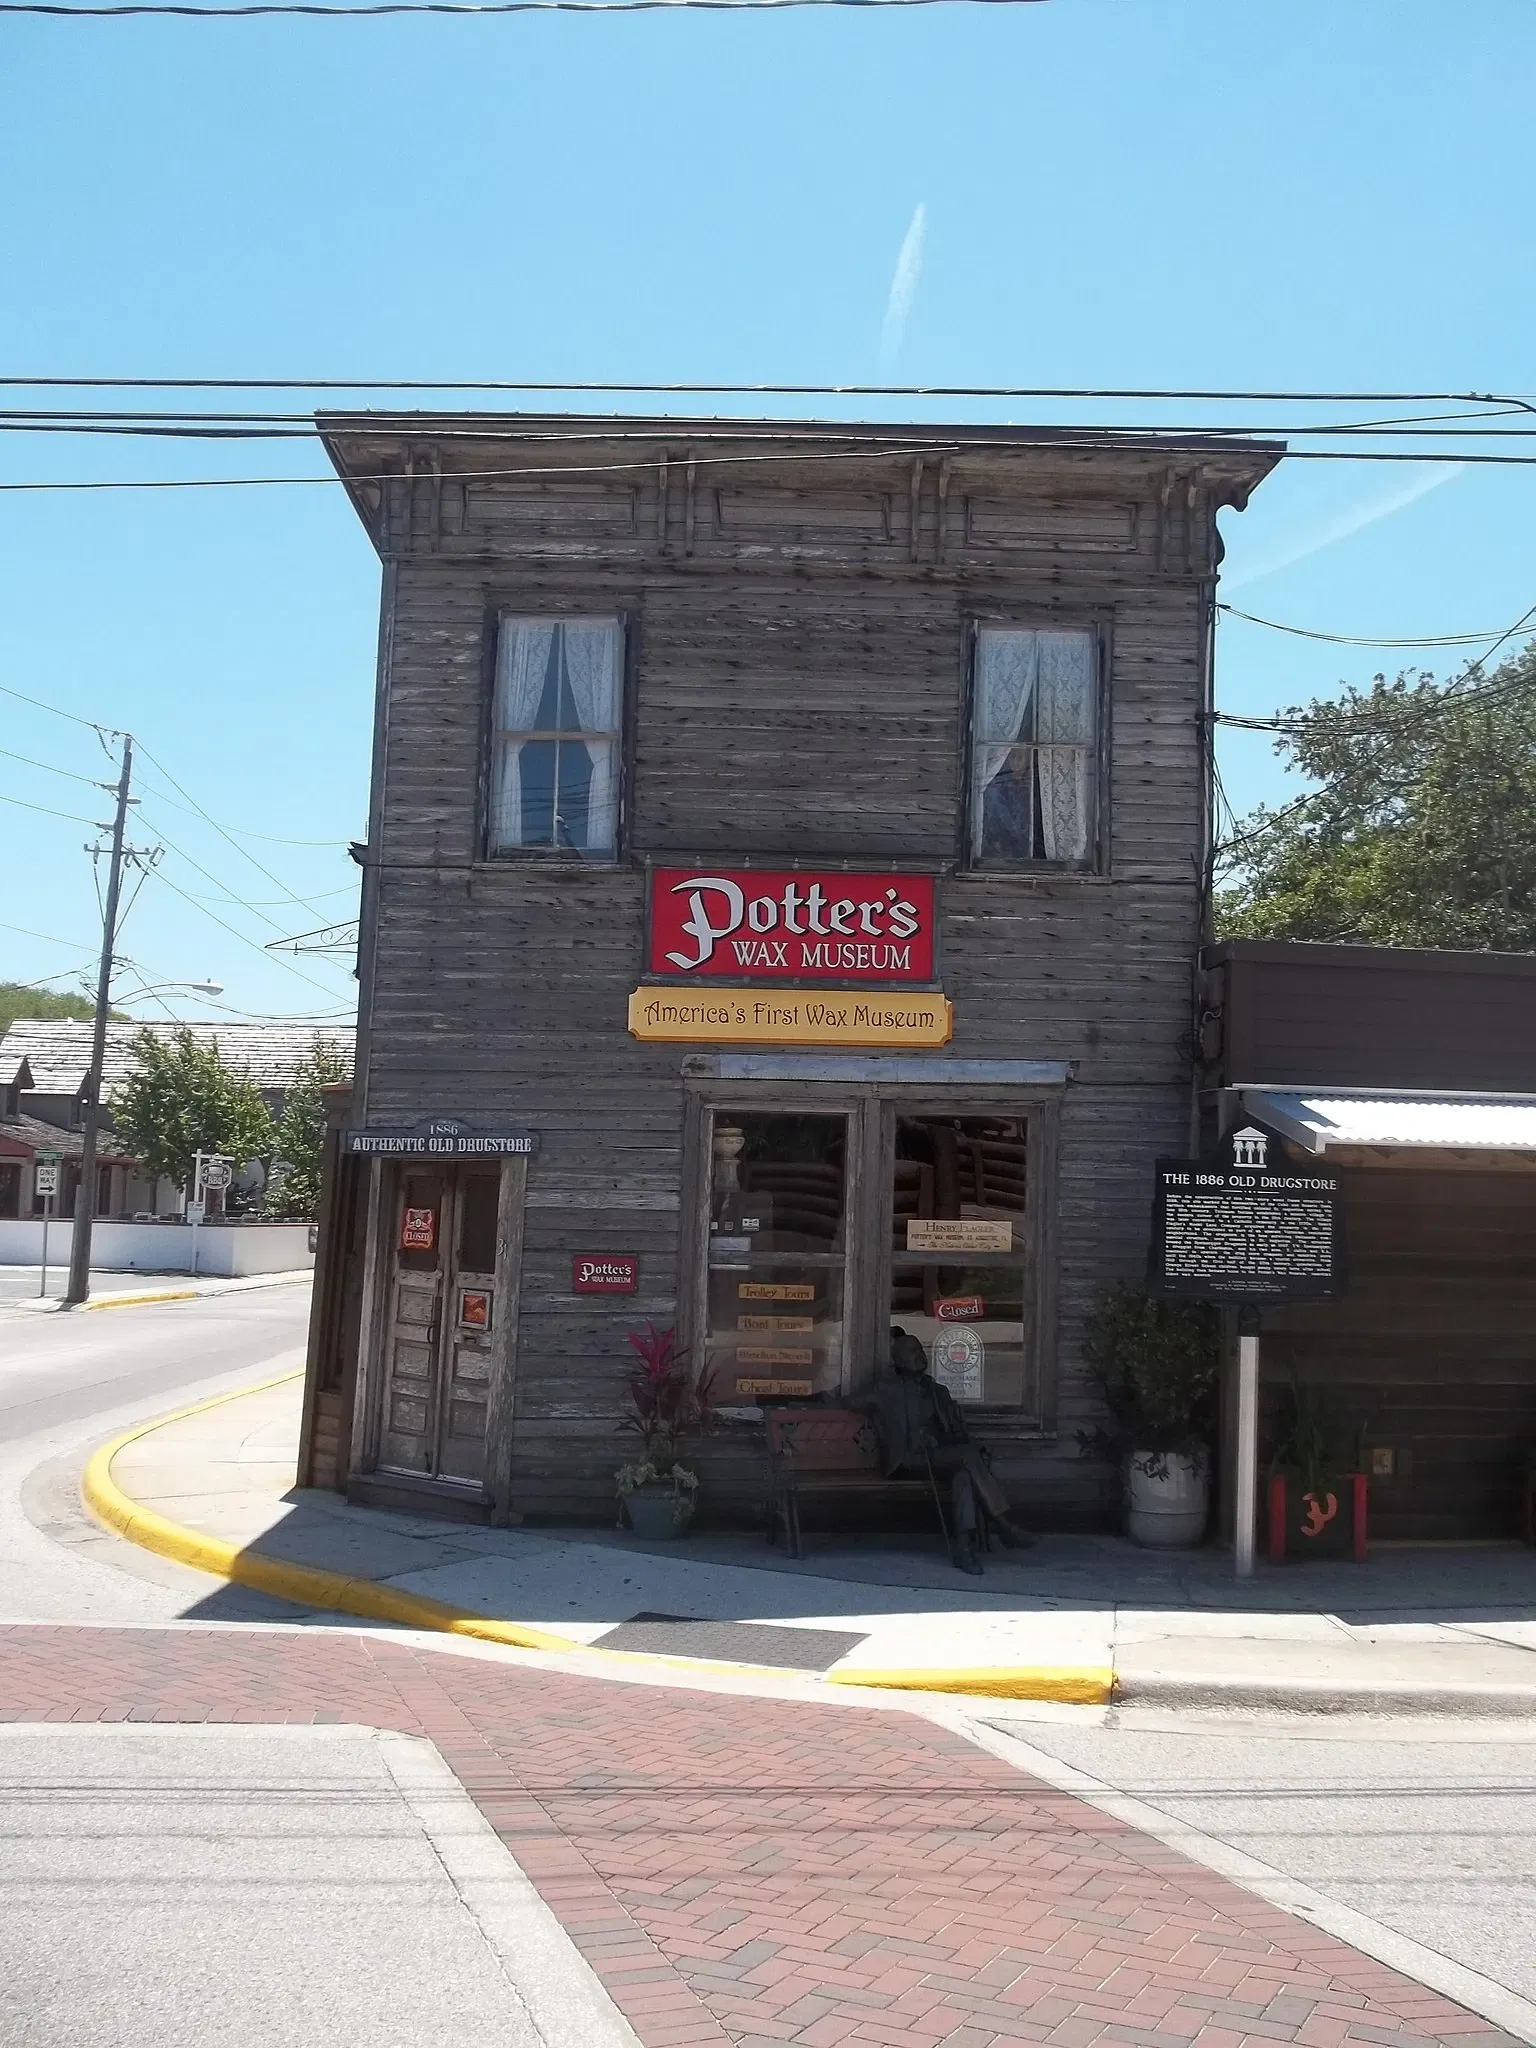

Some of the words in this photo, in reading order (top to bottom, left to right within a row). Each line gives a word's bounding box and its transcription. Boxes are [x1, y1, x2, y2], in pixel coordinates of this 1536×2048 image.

[664, 876, 920, 971] Potter's
[731, 940, 789, 967] WAX
[800, 942, 911, 970] MUSEUM
[644, 1001, 746, 1026] America's
[753, 1002, 799, 1026] First
[806, 1003, 847, 1028] Wax
[852, 1005, 935, 1030] Museum
[430, 1124, 458, 1136] 1886
[352, 1137, 425, 1151] AUTHENTIC
[429, 1138, 454, 1152] OLD
[458, 1138, 532, 1153] DRUGSTORE
[40, 1168, 56, 1177] ONE
[40, 1176, 56, 1184] WAY
[1163, 1173, 1191, 1185] THE
[1195, 1174, 1225, 1186] 1886
[1229, 1175, 1256, 1187] OLD
[1260, 1176, 1337, 1190] DRUGSTORE
[926, 1222, 957, 1233] HENRY
[960, 1222, 994, 1233] FLAGLER
[406, 1231, 430, 1241] CLOSED
[578, 1262, 632, 1282] Potter's
[606, 1276, 631, 1284] MUSEUM
[744, 1285, 777, 1299] Trolley
[783, 1286, 810, 1299] Tours
[938, 1299, 979, 1318] Closed
[739, 1380, 772, 1393] Ghost
[777, 1382, 809, 1394] Tours
